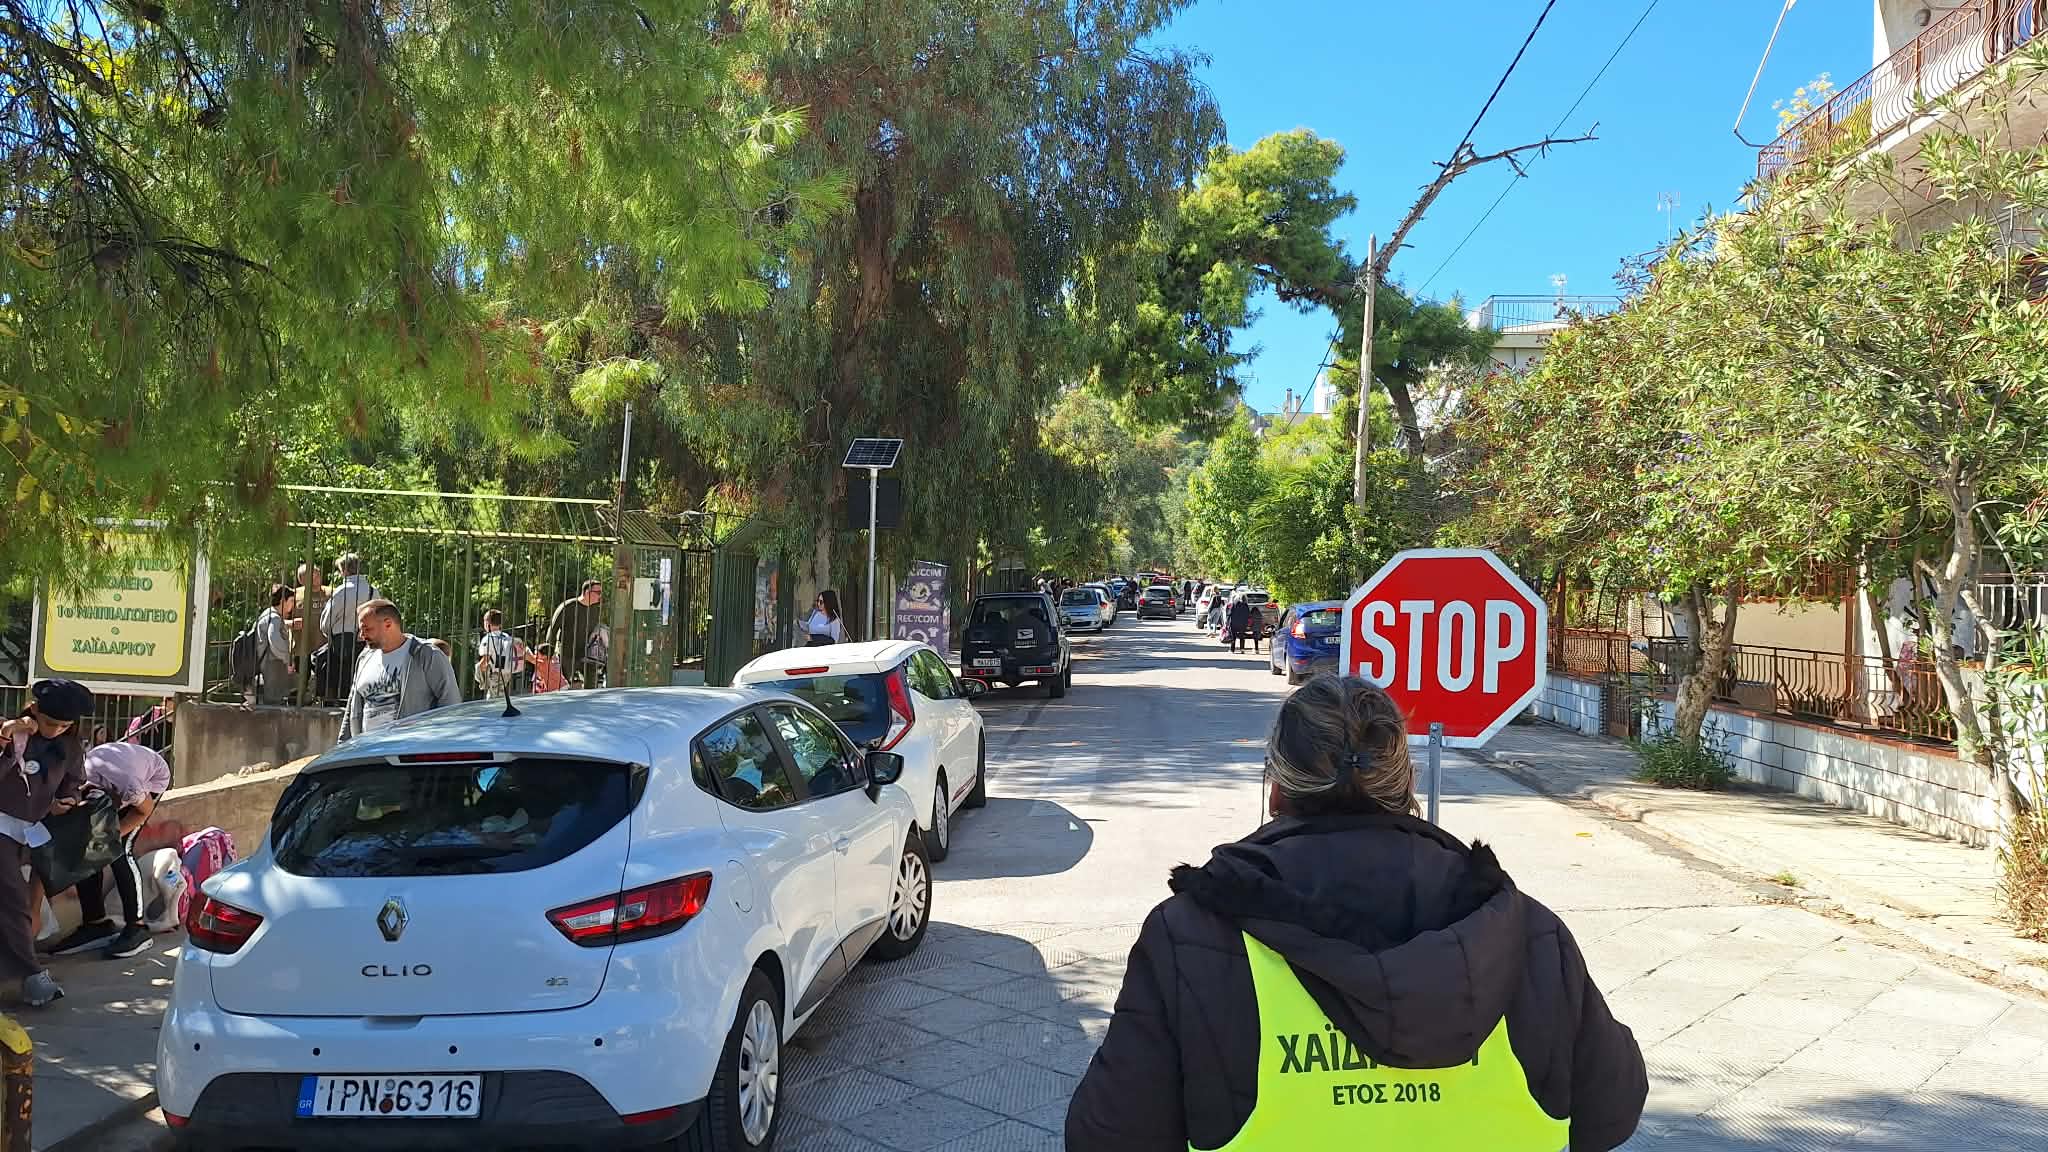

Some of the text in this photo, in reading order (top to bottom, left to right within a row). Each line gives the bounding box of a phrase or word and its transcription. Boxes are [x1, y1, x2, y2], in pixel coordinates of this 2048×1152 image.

[897, 614, 940, 625] RECYCOM
[72, 636, 156, 657] ΧΑΪΔΑΡΙΟΥ
[1359, 600, 1526, 694] STOP
[361, 964, 433, 977] CLIO
[1333, 1082, 1442, 1106] ΕΤΟΣ 2018
[299, 1099, 312, 1109] GR
